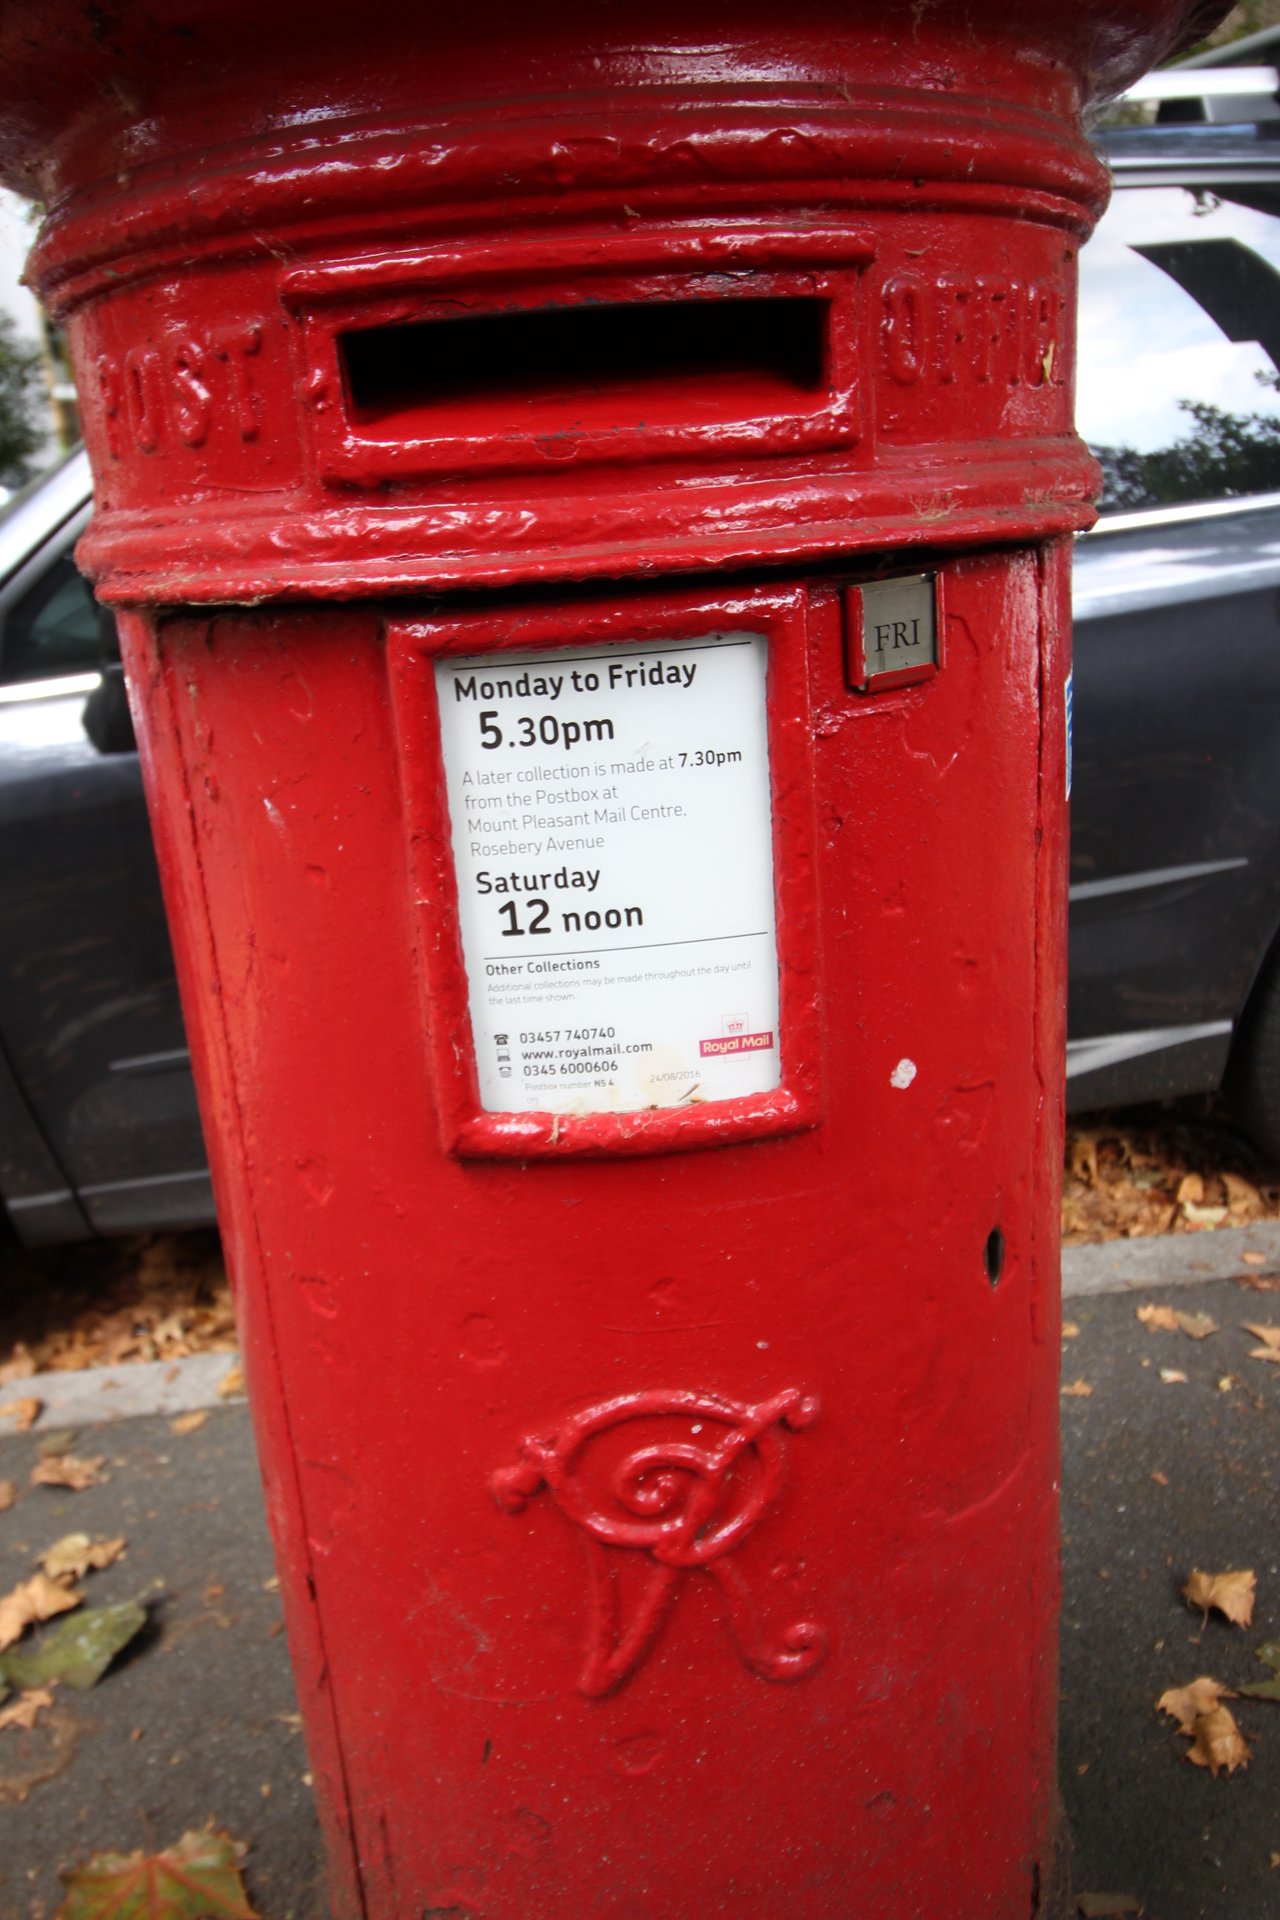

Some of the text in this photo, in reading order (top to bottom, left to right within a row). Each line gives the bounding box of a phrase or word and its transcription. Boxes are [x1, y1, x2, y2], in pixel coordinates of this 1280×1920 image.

[874, 619, 920, 653] FRI
[454, 661, 696, 702] Monday to Friday
[479, 711, 614, 750] 5.30pm
[463, 750, 741, 786] A later collection is made at 7.30pm
[464, 786, 619, 810] from the Postbox at
[468, 818, 519, 833] Mount
[522, 812, 590, 830] Pleasant
[594, 807, 626, 824] Mail
[470, 837, 604, 856] Rosebery Avenue
[476, 867, 600, 894] Saturday
[498, 899, 643, 936] 12 noon
[486, 959, 600, 976] Other Collections
[488, 960, 752, 992] Additional collections may be made throughout the day until
[489, 996, 504, 1006] the
[506, 995, 522, 1005] last
[523, 994, 544, 1004] time
[520, 1027, 615, 1044] 03457 740740
[703, 1035, 769, 1054] Royal Mail
[521, 1041, 652, 1061] www.royalmail.com
[523, 1060, 618, 1076] 0345 6000606
[650, 1070, 702, 1084] 24/08/2016
